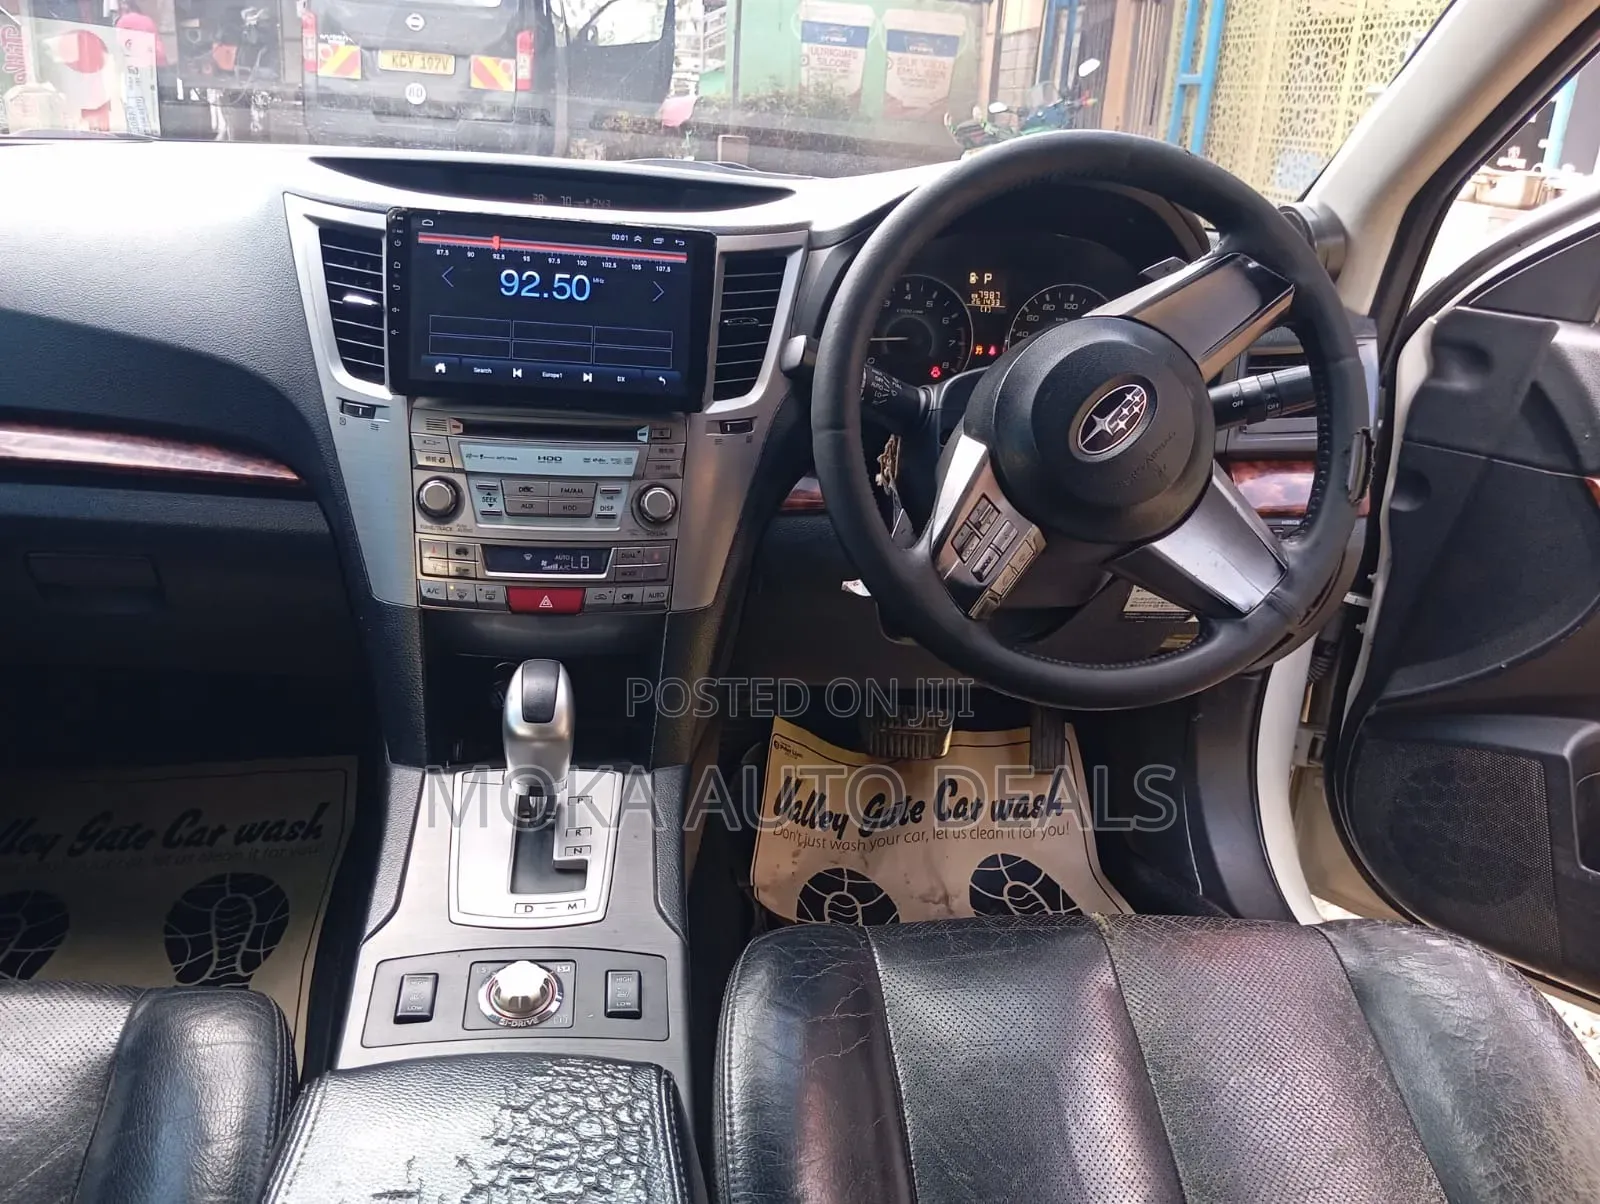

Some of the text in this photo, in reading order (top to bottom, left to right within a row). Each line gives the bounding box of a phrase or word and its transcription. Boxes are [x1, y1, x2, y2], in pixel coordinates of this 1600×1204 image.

[577, 259, 587, 267] 100
[983, 272, 993, 284] P
[500, 269, 591, 301] 92.50
[941, 316, 950, 325] 6
[473, 366, 492, 375] Search
[1232, 400, 1244, 408] OFF
[426, 587, 440, 595] A/C
[773, 768, 1064, 840] Valley Gate Car wash
[67, 810, 156, 857] Gate
[162, 808, 229, 850] Car
[234, 802, 331, 847] wash
[773, 821, 1070, 852] Don't just wash your car, let us clean it for you!
[524, 902, 578, 913] D M
